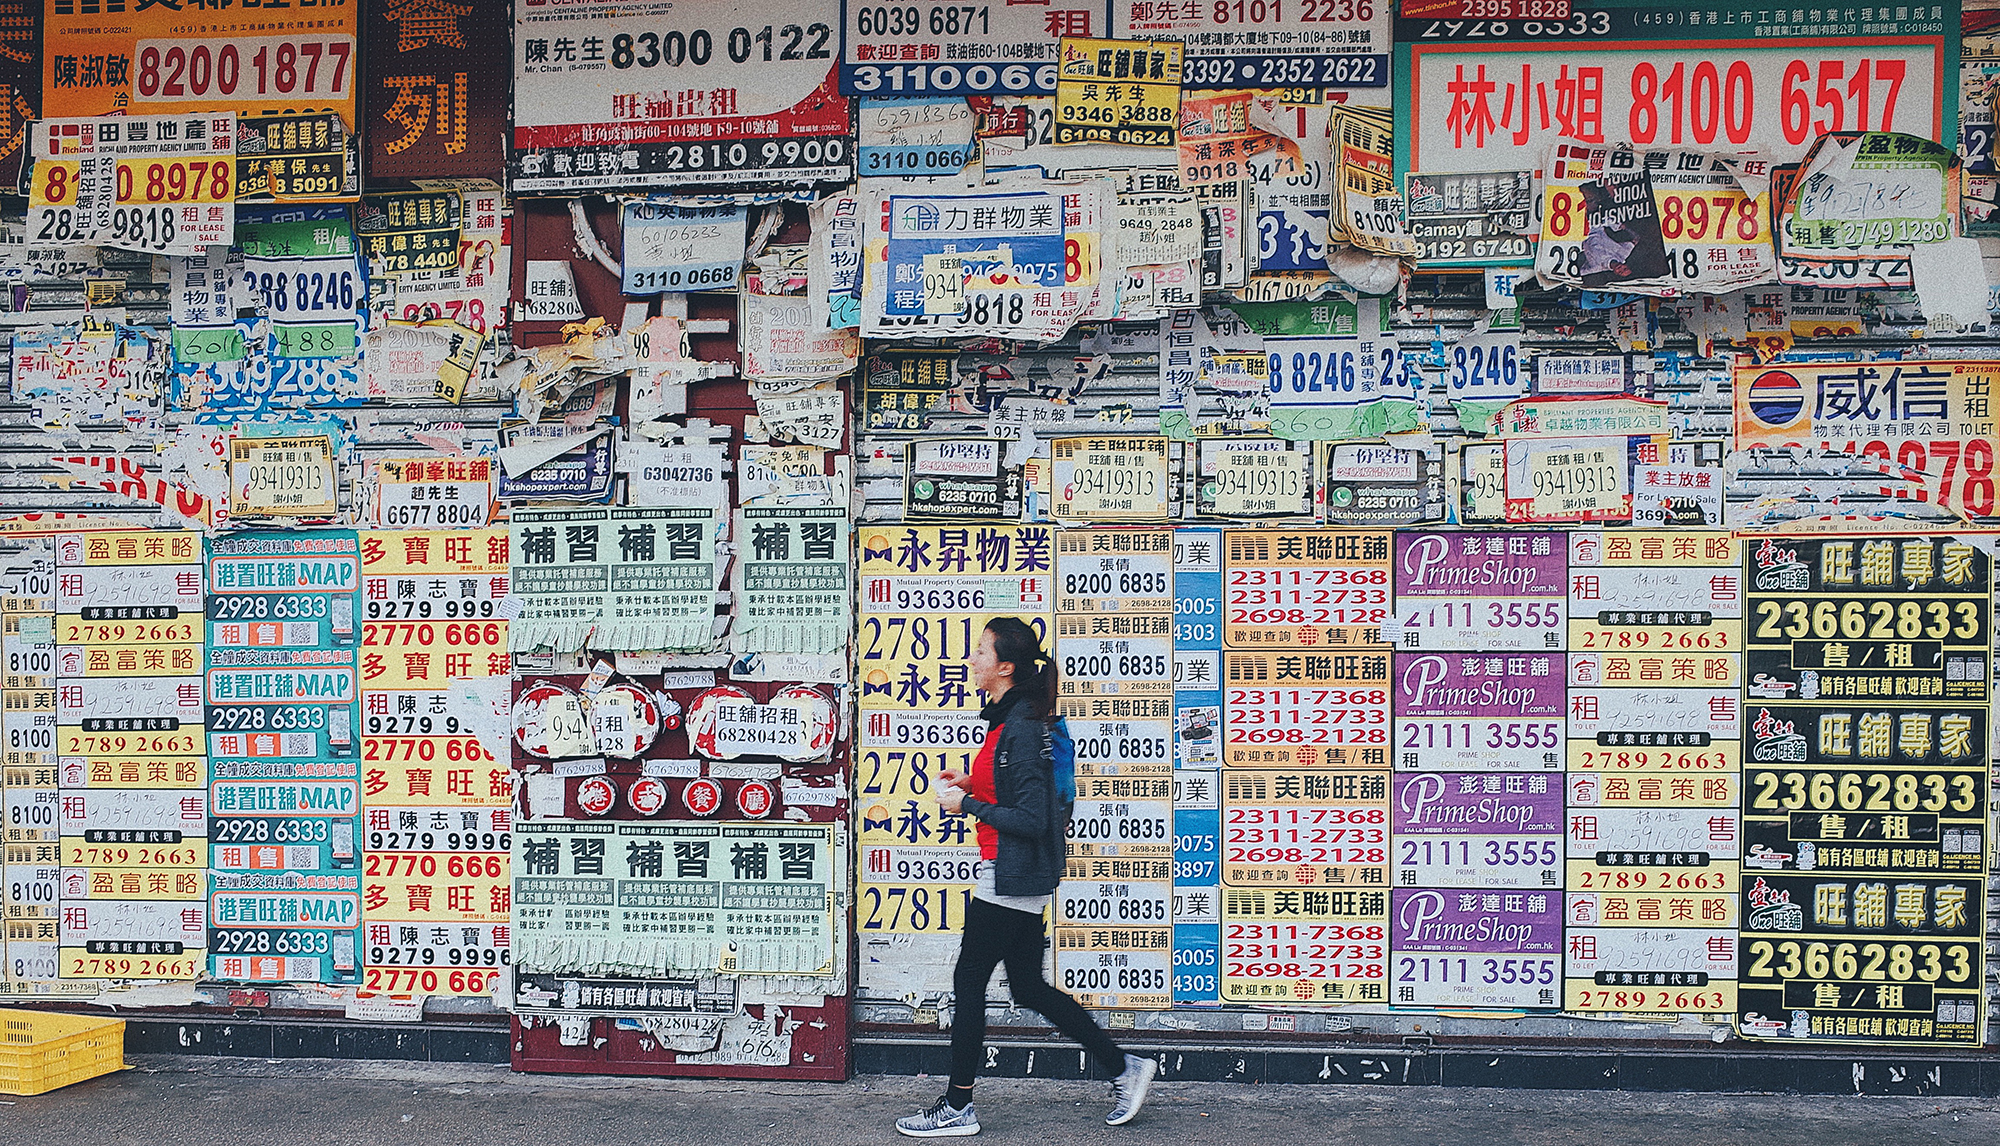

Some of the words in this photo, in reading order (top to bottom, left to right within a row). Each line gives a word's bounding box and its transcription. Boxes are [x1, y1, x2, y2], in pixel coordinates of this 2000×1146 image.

[589, 5, 619, 13] PROPERTY
[1131, 1, 1203, 22] 鄭先生
[1213, 0, 1281, 24] 8101
[1301, 0, 1373, 22] 2236
[1462, 0, 1512, 17] 2395
[1518, 0, 1568, 17] 1828
[858, 7, 919, 35] 6039
[929, 6, 989, 35] 6871
[525, 36, 605, 63] 陳先生
[612, 30, 711, 69] 8300
[728, 23, 830, 62] 0122
[857, 44, 940, 61] 歡迎查詢
[54, 54, 129, 88] 陳淑敏
[139, 44, 240, 96] 8200
[253, 42, 350, 94] 1877
[541, 65, 562, 73] Chan
[1097, 49, 1165, 79] 旺舖專家
[1261, 59, 1313, 82] 2352
[1322, 58, 1376, 82] 2622
[1082, 85, 1145, 101] 吳先生
[1443, 64, 1604, 149] 林小姐
[1629, 60, 1753, 144] 8100
[1781, 59, 1906, 145] 6517
[1063, 105, 1113, 122] 9346
[1121, 105, 1172, 121] 3888
[99, 121, 206, 141] 田豐地產
[1060, 129, 1111, 143] 6108
[1118, 130, 1169, 144] 0624
[129, 145, 158, 153] PROPERTY
[160, 144, 182, 152] AGENCY
[184, 142, 206, 151] LIMITED
[668, 144, 747, 169] 2810
[762, 140, 844, 164] 9900
[869, 152, 918, 169] 3110
[1187, 162, 1237, 181] 9018
[1567, 170, 1603, 179] Richland
[1680, 174, 1708, 184] AGENCY
[1710, 174, 1734, 184] LIMITED
[147, 162, 229, 200] 8978
[293, 177, 337, 192] 5091
[97, 157, 114, 227] 68280428
[1614, 183, 1648, 203] YOUR
[182, 207, 199, 222] 租
[207, 207, 225, 221] 售
[946, 204, 1053, 229] 力群物業
[1663, 197, 1759, 240] 8978
[1119, 218, 1152, 230] 9649
[1161, 218, 1193, 230] 2848
[1844, 224, 1895, 244] 2749
[1899, 222, 1947, 241] 1280
[371, 234, 427, 252] 胡偉忠
[1416, 241, 1466, 258] 9192
[1473, 239, 1526, 256] 6740
[414, 251, 454, 268] 4400
[1708, 248, 1727, 262] 租
[1737, 247, 1758, 261] 售
[1707, 264, 1723, 272] FOR
[1726, 262, 1761, 271] LEASE
[634, 272, 680, 287] 3110
[688, 267, 733, 284] 0668
[296, 271, 353, 311] 8246
[1291, 351, 1354, 392] 8246
[1814, 366, 1951, 421] 威信
[996, 407, 1066, 422] 業主放盤
[1545, 415, 1661, 431] 卓越物業有限公司
[802, 426, 838, 440] 3127
[1814, 422, 1950, 438] 物業代理有限公司
[1960, 423, 1973, 435] TO
[1976, 423, 1993, 435] LET
[249, 463, 322, 490] 93419313
[531, 471, 560, 482] 6235
[561, 469, 587, 480] 0710
[643, 467, 713, 483] 63042736
[1073, 468, 1154, 495] 93419313
[1215, 469, 1298, 496] 93419313
[1533, 466, 1616, 497] 93419313
[1645, 471, 1711, 487] 業主放盤
[411, 485, 459, 500] 趙先生
[503, 482, 587, 494] hkshopexpert.com
[939, 492, 966, 503] 6235
[969, 491, 996, 503] 0710
[912, 502, 998, 514] hkshopexpert.com
[1358, 496, 1387, 509] 6235
[1390, 496, 1417, 508] 0710
[387, 504, 431, 526] 6677
[436, 504, 482, 524] 8804
[1331, 509, 1420, 522] hkshopexpert.com
[88, 536, 192, 560] 盈富策略
[521, 525, 599, 563] 補習
[897, 528, 1050, 572] 永昇物業
[1093, 534, 1169, 552] 美聯旺舖
[1277, 536, 1387, 560] 美聯旺舖
[1463, 537, 1551, 555] 澎達旺舖
[1607, 537, 1730, 559] 盈富策略
[1404, 535, 1536, 592] PrimeShop
[1822, 542, 1974, 586] 旺舖專家
[218, 563, 295, 586] 港置旺舖
[301, 563, 352, 586] MAP
[1231, 571, 1387, 584] 2311-7368
[398, 579, 477, 599] 陳志寶
[1066, 574, 1110, 594] 8200
[1120, 574, 1166, 594] 6835
[1572, 575, 1600, 600] 租
[1709, 575, 1737, 600] 售
[1231, 590, 1386, 604] 2311-2733
[215, 597, 268, 618] 2928
[274, 596, 326, 618] 6333
[368, 602, 432, 618] 9279
[1488, 603, 1559, 627] 3555
[1609, 613, 1702, 623] 專業旺舖代理
[1756, 601, 1979, 638] 23662833
[68, 626, 125, 641] 2789
[136, 624, 192, 640] 2663
[363, 624, 434, 645] 2770
[1235, 631, 1290, 642] 歡迎查詢
[1543, 632, 1559, 647] 售
[1583, 632, 1649, 648] 2789
[1661, 632, 1727, 648] 2663
[664, 675, 714, 685] 67629788
[1821, 677, 1892, 696] 倘有各區旺舖
[1896, 677, 1943, 696] 歡迎查詢
[1230, 690, 1386, 705] 2311-7368
[719, 706, 798, 724] 旺舖招租
[718, 730, 797, 745] 68280428
[1119, 817, 1165, 838] 6835
[92, 874, 198, 894] 盈富策略
[1226, 963, 1383, 978] 2698-2128
